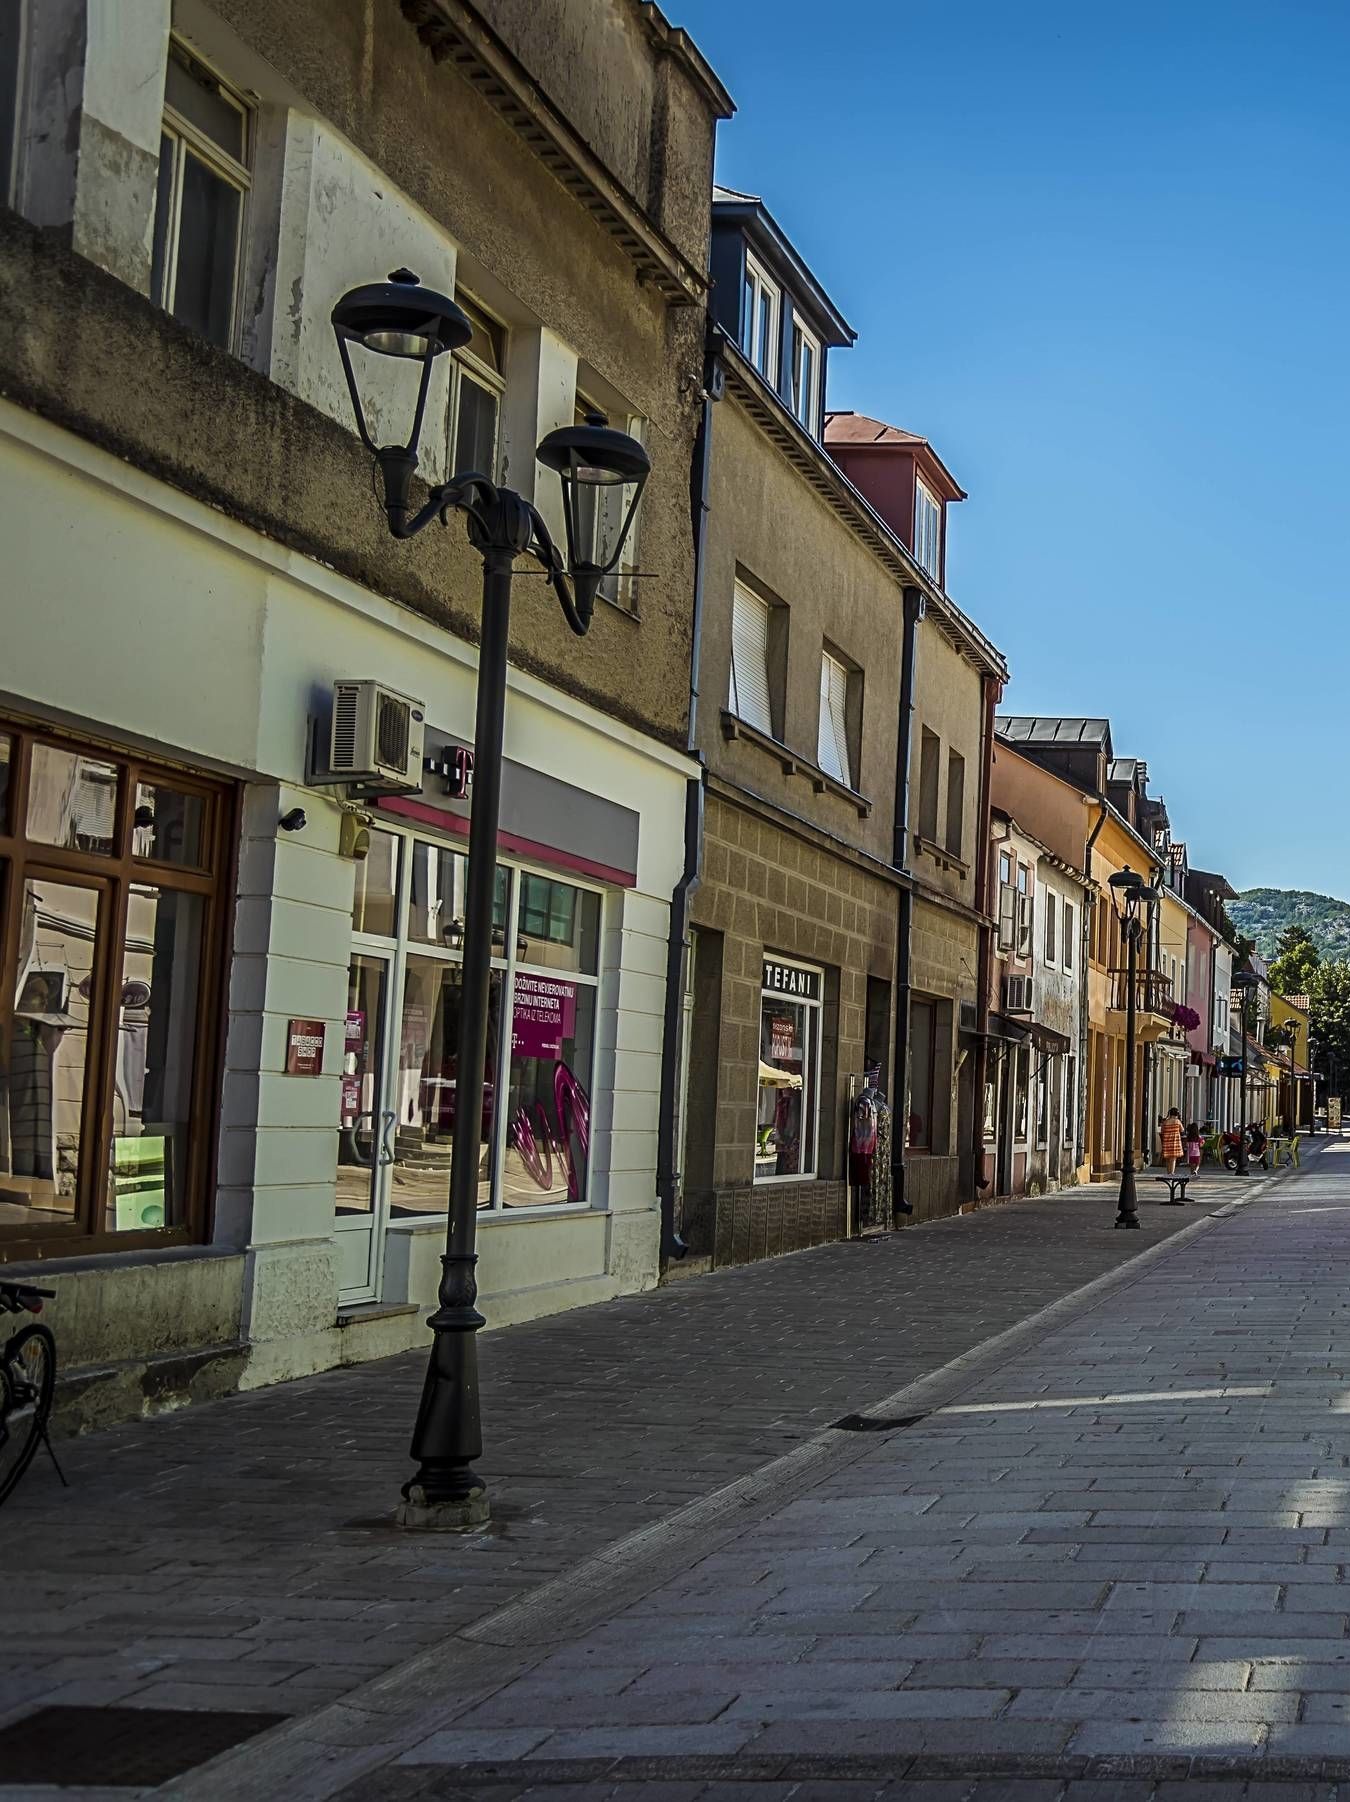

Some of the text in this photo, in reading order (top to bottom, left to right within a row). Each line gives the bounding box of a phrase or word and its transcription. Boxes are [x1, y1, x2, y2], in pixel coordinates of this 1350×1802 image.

[514, 976, 574, 998] DOŽIVITE NEVJEROVATNU
[765, 964, 811, 995] TEFANI
[514, 992, 560, 1010] BRZINU INTERNETA
[537, 1010, 561, 1024] TELEKOMA
[292, 1035, 323, 1047] TABACCO
[298, 1046, 317, 1057] SHOP
